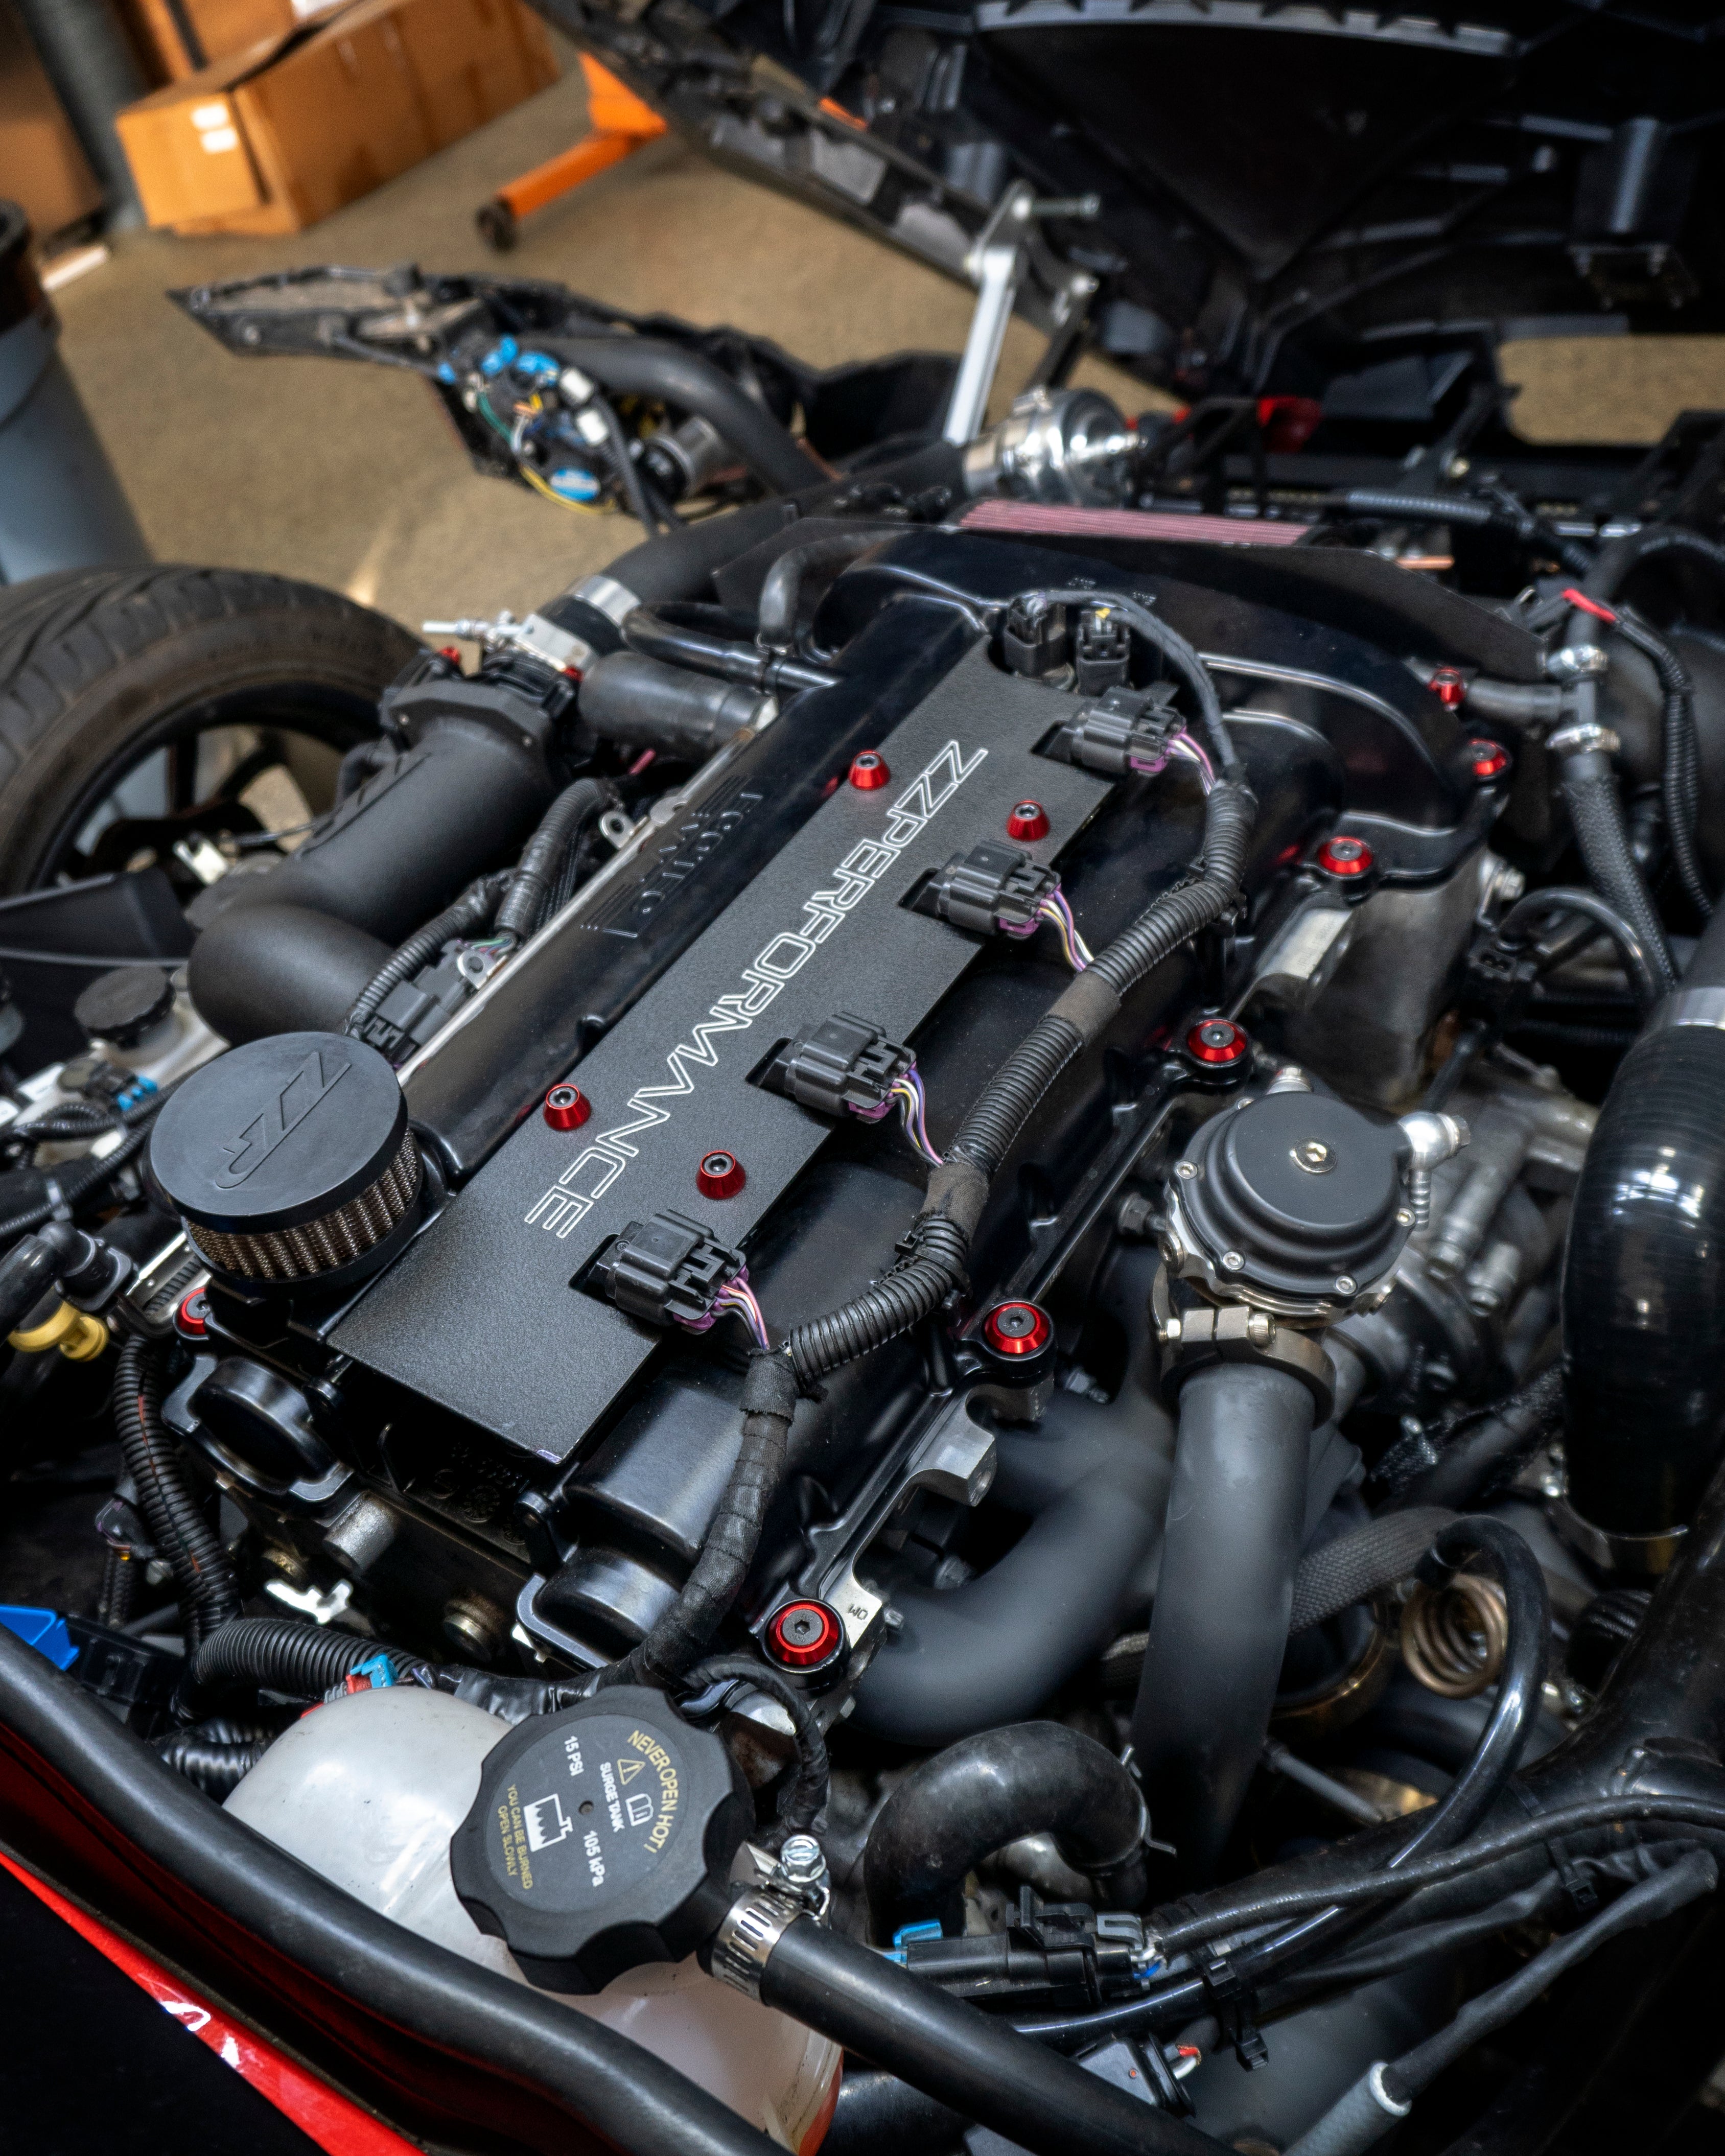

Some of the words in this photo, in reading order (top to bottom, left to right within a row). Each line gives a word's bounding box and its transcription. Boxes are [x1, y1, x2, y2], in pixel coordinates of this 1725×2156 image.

[525, 740, 988, 1239] ZZPERFORMANCE
[564, 1736, 579, 1752] 15
[567, 1751, 585, 1776] PSI
[626, 1729, 670, 1772] NEVER
[659, 1768, 679, 1812] OPEN
[507, 1784, 519, 1806] YOU
[600, 1762, 619, 1803] SURGE
[498, 1805, 510, 1834] OPEN
[511, 1807, 523, 1830] CAN
[608, 1800, 625, 1833] TANK
[514, 1829, 526, 1845] BE
[584, 1830, 602, 1857] 105
[502, 1834, 518, 1877] SLOWLY
[517, 1844, 533, 1889] BURNED
[589, 1856, 605, 1887] kPa
